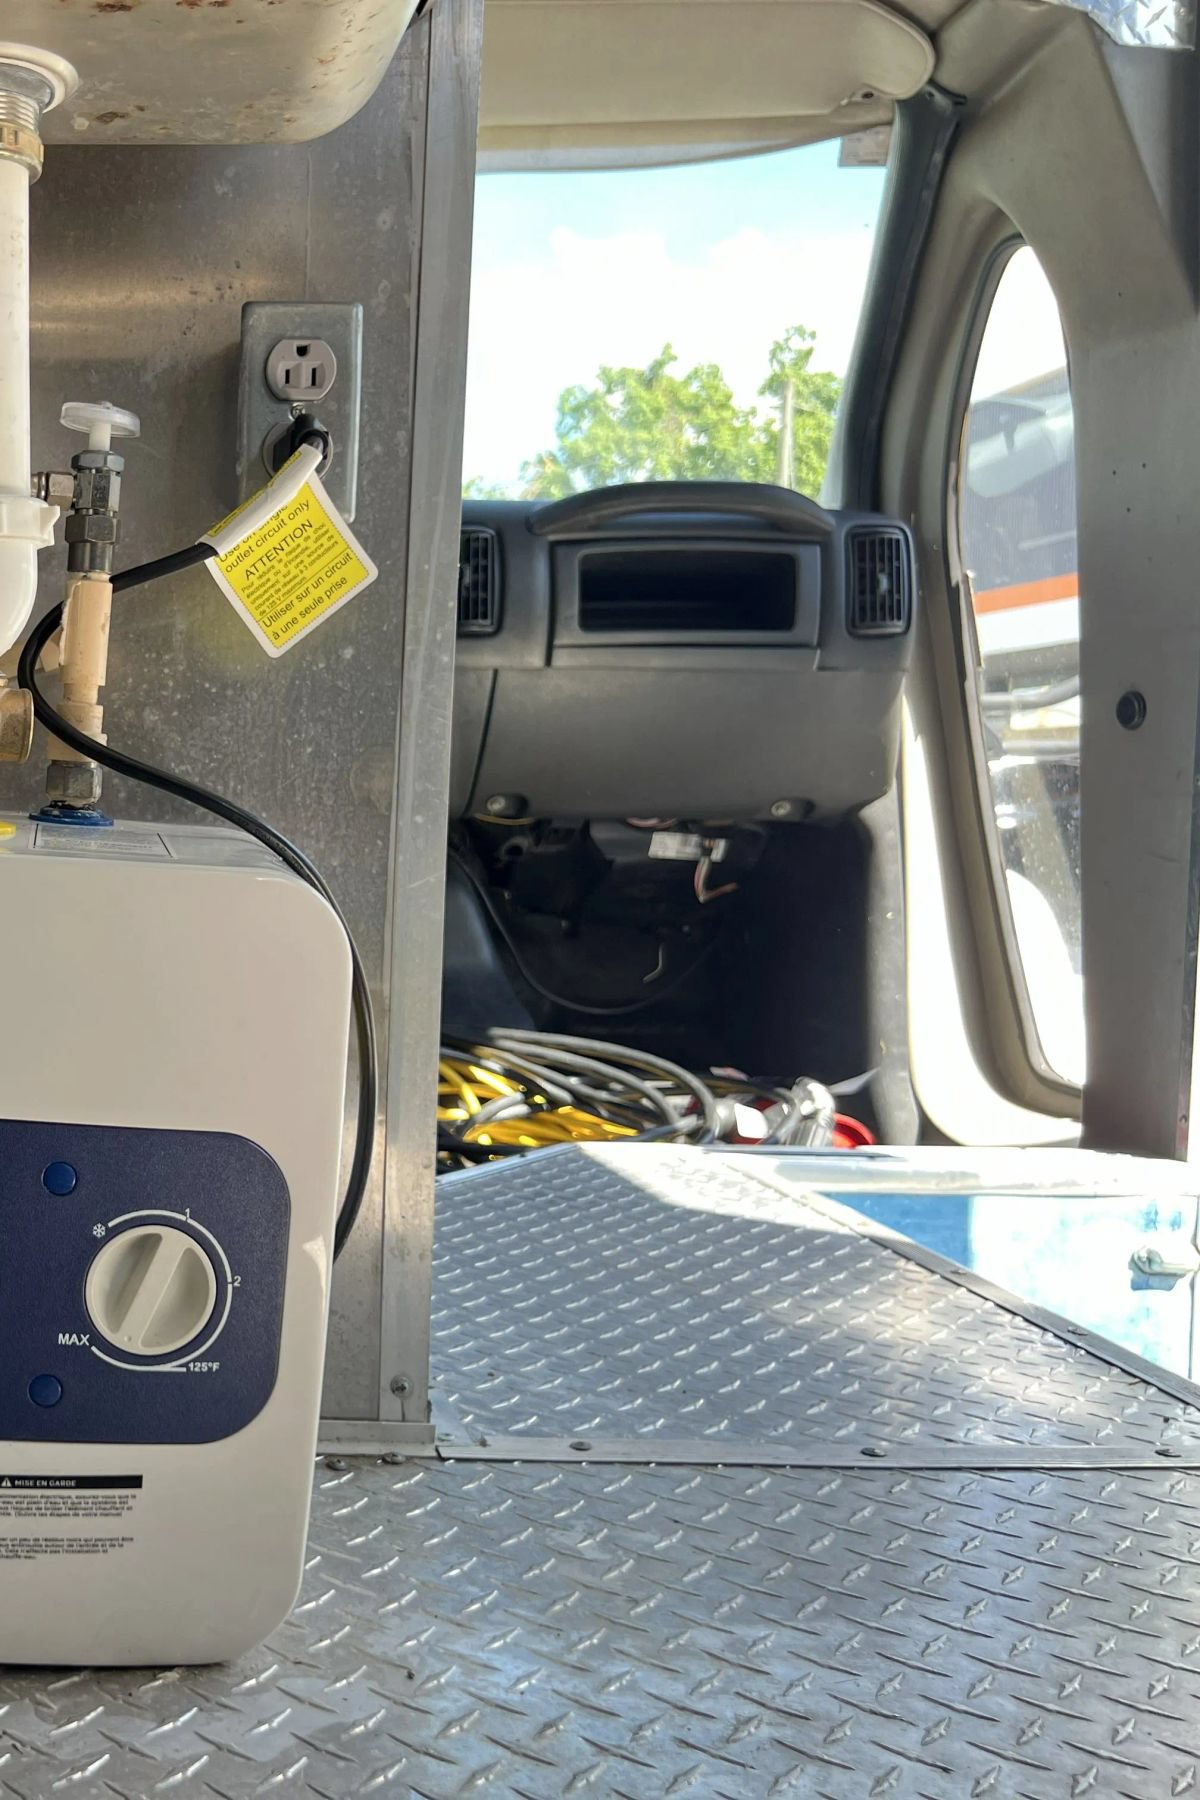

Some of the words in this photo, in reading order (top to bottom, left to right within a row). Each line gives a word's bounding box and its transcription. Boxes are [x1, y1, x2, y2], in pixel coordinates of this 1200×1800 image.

[219, 543, 240, 563] Use
[225, 546, 254, 573] outlet
[255, 519, 287, 549] circuit
[288, 500, 311, 521] only
[244, 519, 314, 581] ATTENTION
[263, 598, 295, 628] Utiliser
[296, 585, 311, 603] sur
[312, 575, 325, 591] un
[325, 553, 353, 578] circuit
[272, 629, 280, 641] à
[279, 615, 299, 636] une
[299, 596, 325, 618] seule
[325, 576, 348, 601] prise
[233, 1276, 241, 1287] 2
[58, 1332, 90, 1346] MAX
[188, 1362, 220, 1373] 125°F
